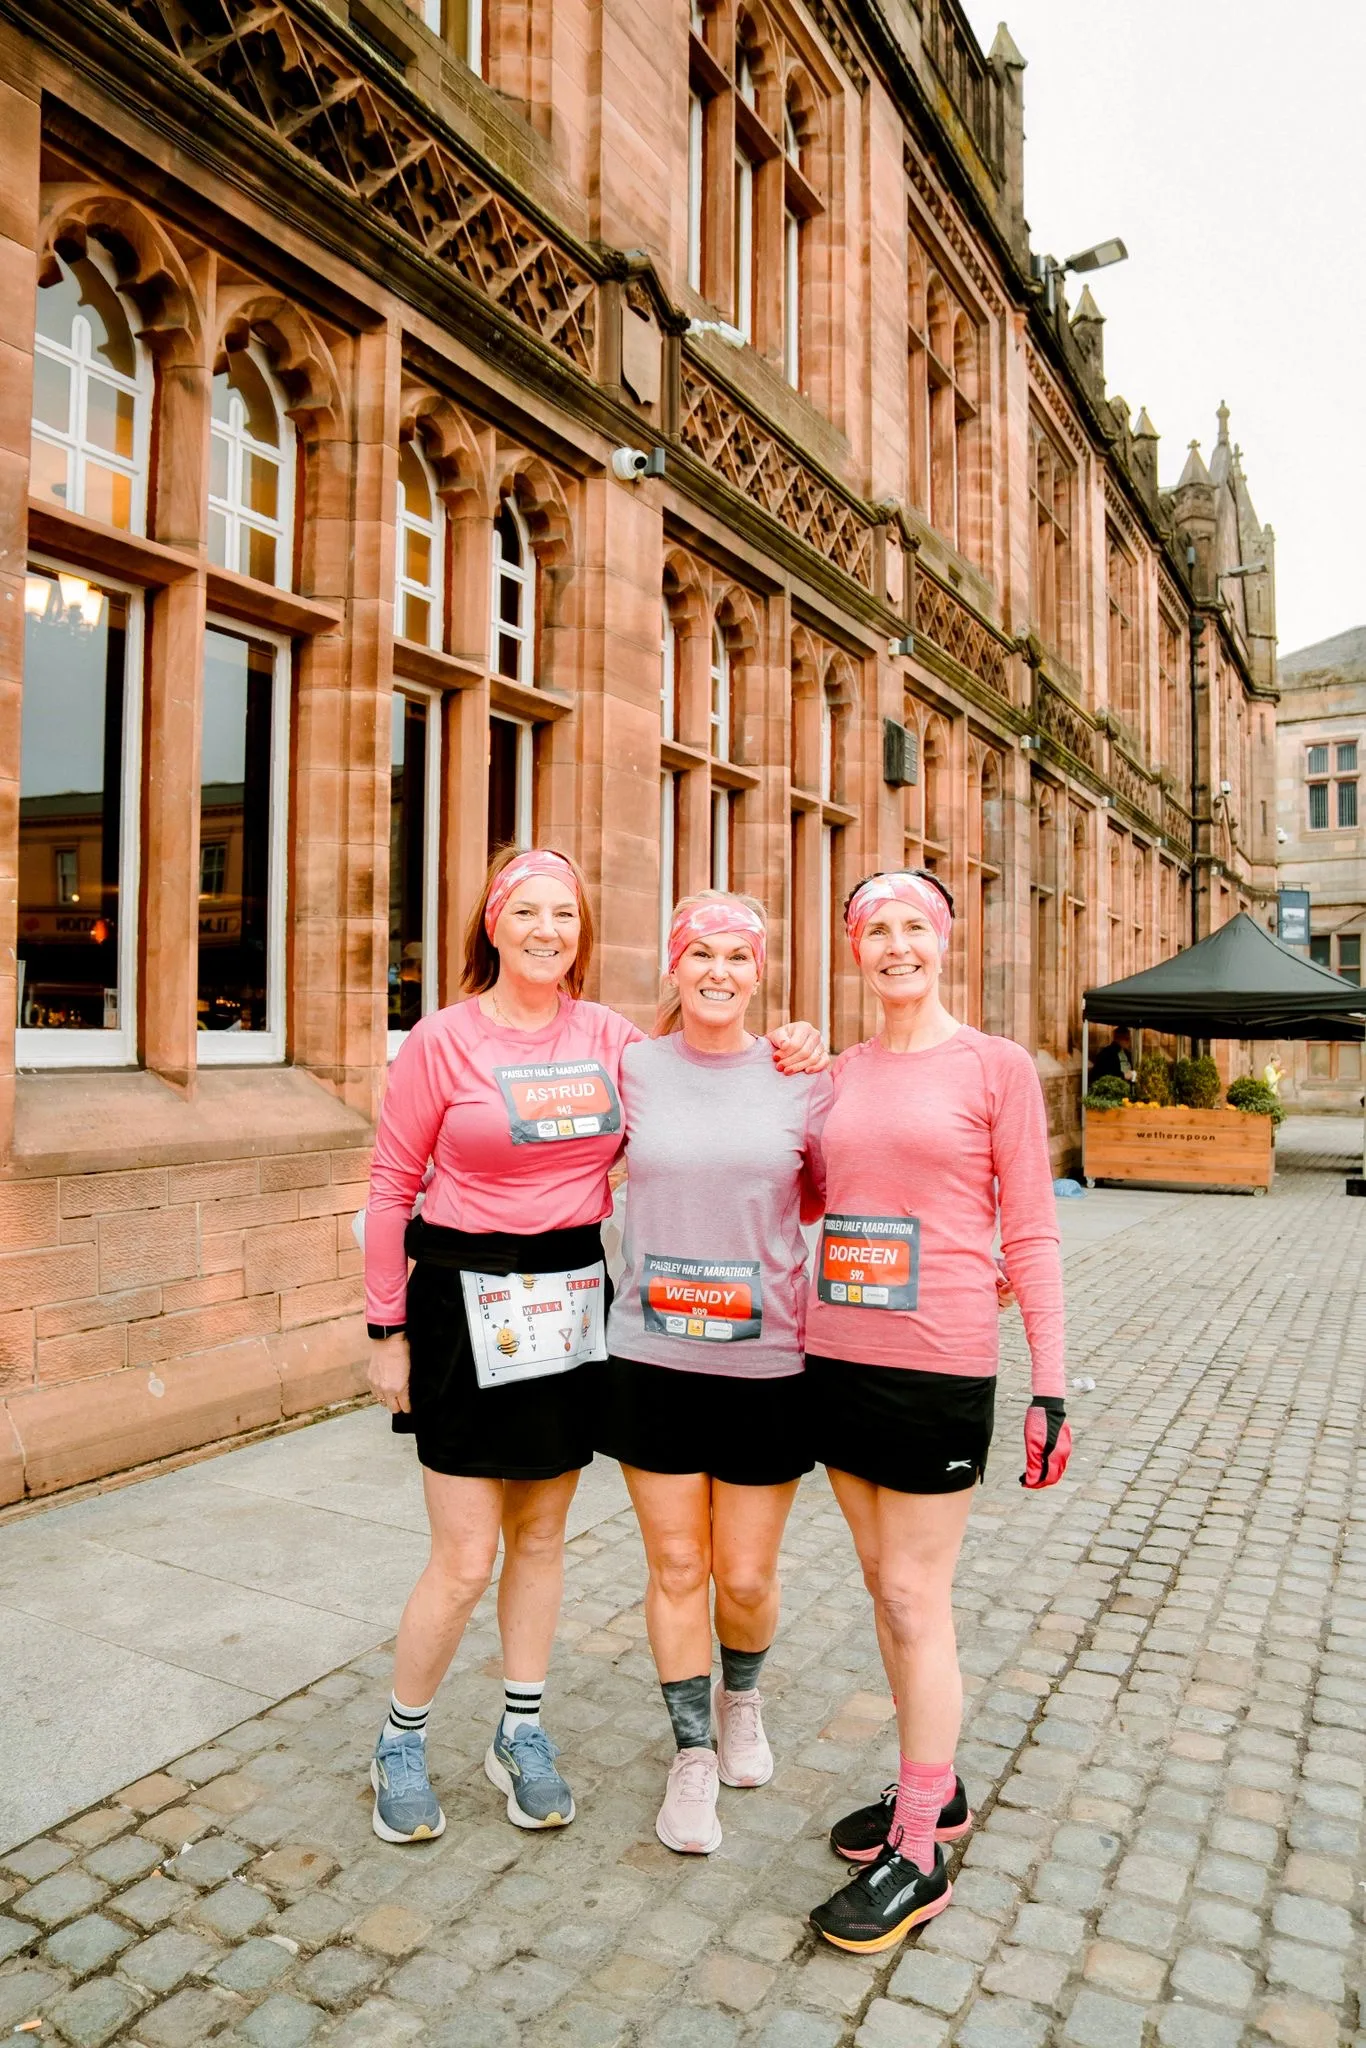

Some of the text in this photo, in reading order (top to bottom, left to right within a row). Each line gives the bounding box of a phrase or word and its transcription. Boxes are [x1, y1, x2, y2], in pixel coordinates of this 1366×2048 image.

[501, 1063, 600, 1079] PAISLEY HALF MARATHON
[526, 1082, 596, 1103] ASTRUD
[1136, 1131, 1216, 1141] wetherspoon
[842, 1221, 862, 1232] HALF
[862, 1222, 914, 1234] MARATHON
[829, 1244, 898, 1265] DOREEN
[650, 1260, 754, 1278] PAISLEY HALF MARATHON
[850, 1269, 865, 1281] 592
[567, 1278, 600, 1290] REPEAT
[481, 1291, 509, 1303] RUN
[665, 1285, 736, 1306] WENDY
[523, 1302, 561, 1315] WALK
